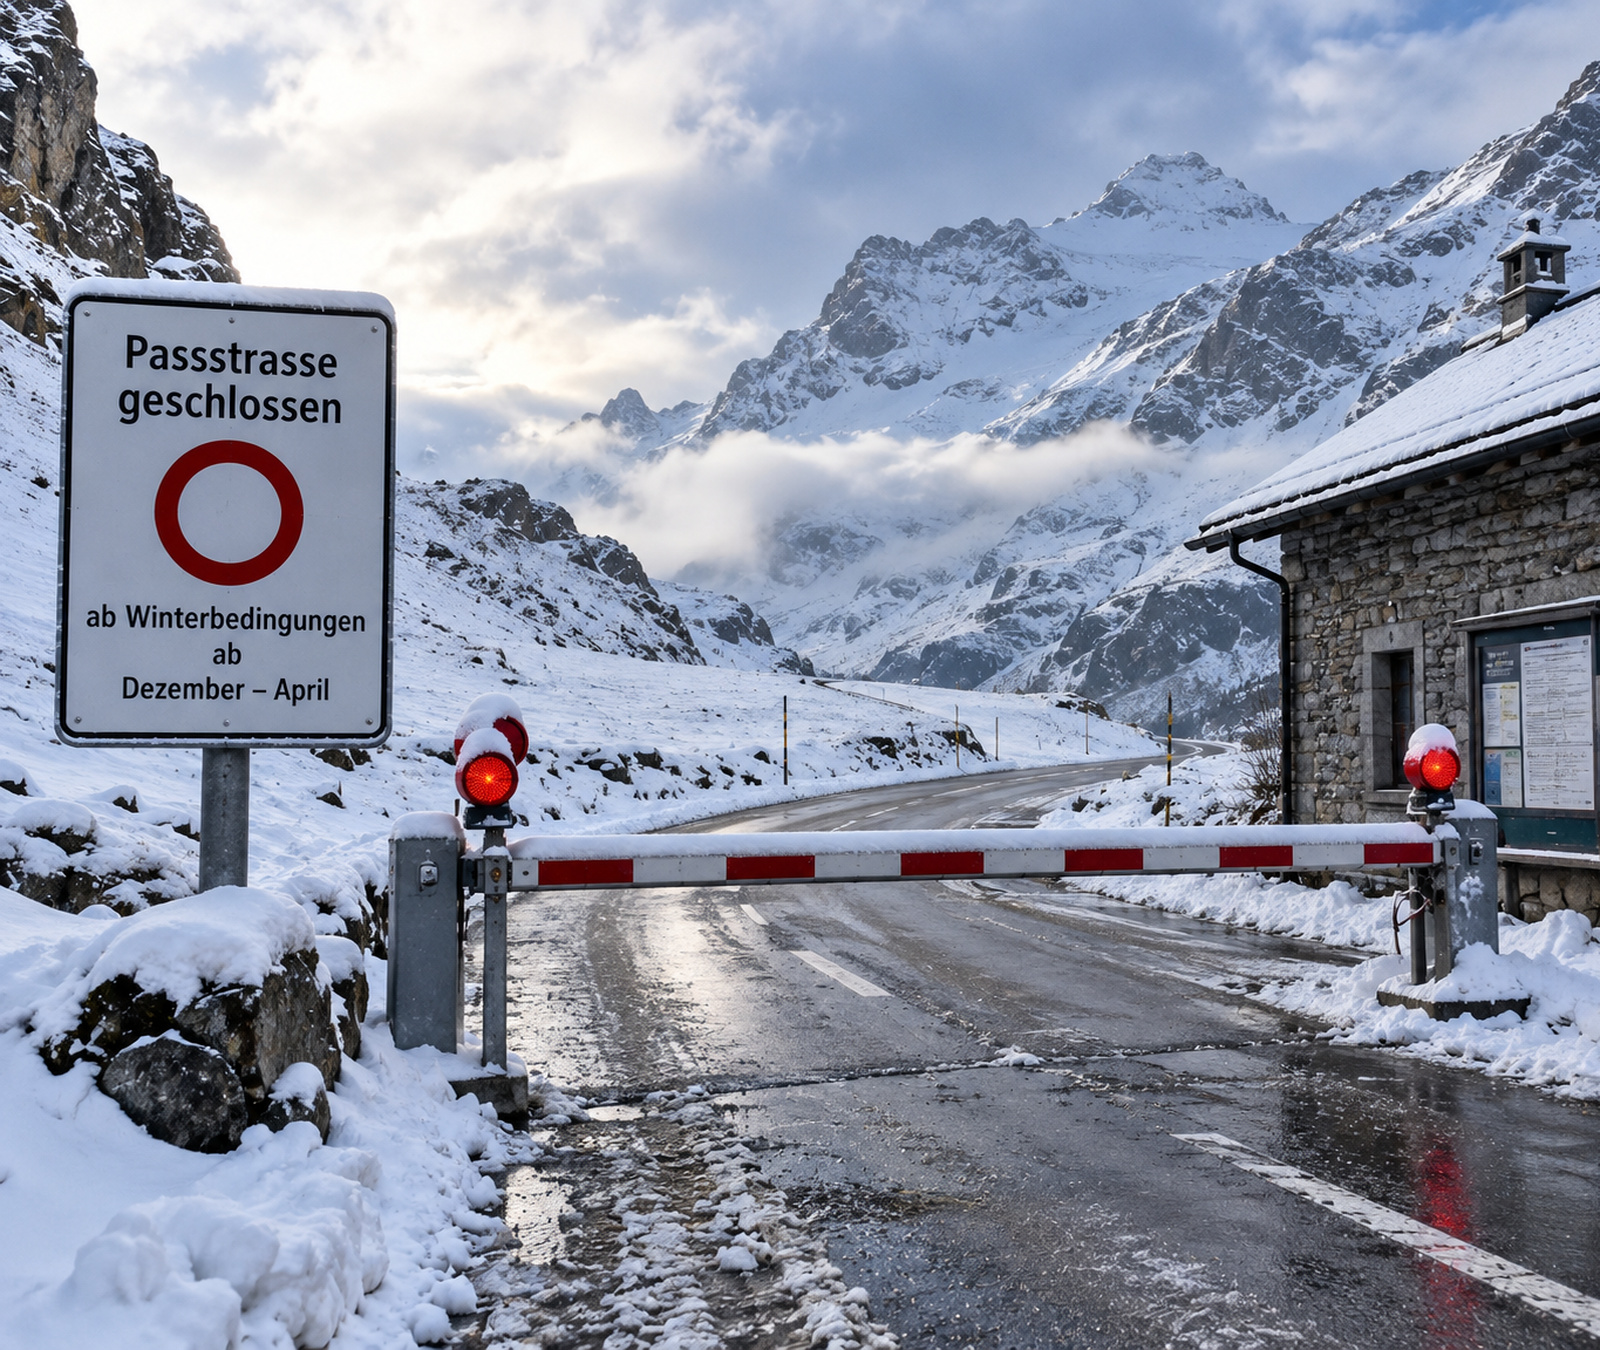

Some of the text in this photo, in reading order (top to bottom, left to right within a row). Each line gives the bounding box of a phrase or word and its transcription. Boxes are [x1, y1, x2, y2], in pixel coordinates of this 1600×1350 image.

[126, 334, 338, 378] Passstrasse
[118, 382, 342, 425] geschlossen
[86, 603, 366, 637] ab Winterbedingungen
[212, 641, 242, 666] ab
[122, 675, 246, 701] Dezember
[273, 677, 330, 707] April
